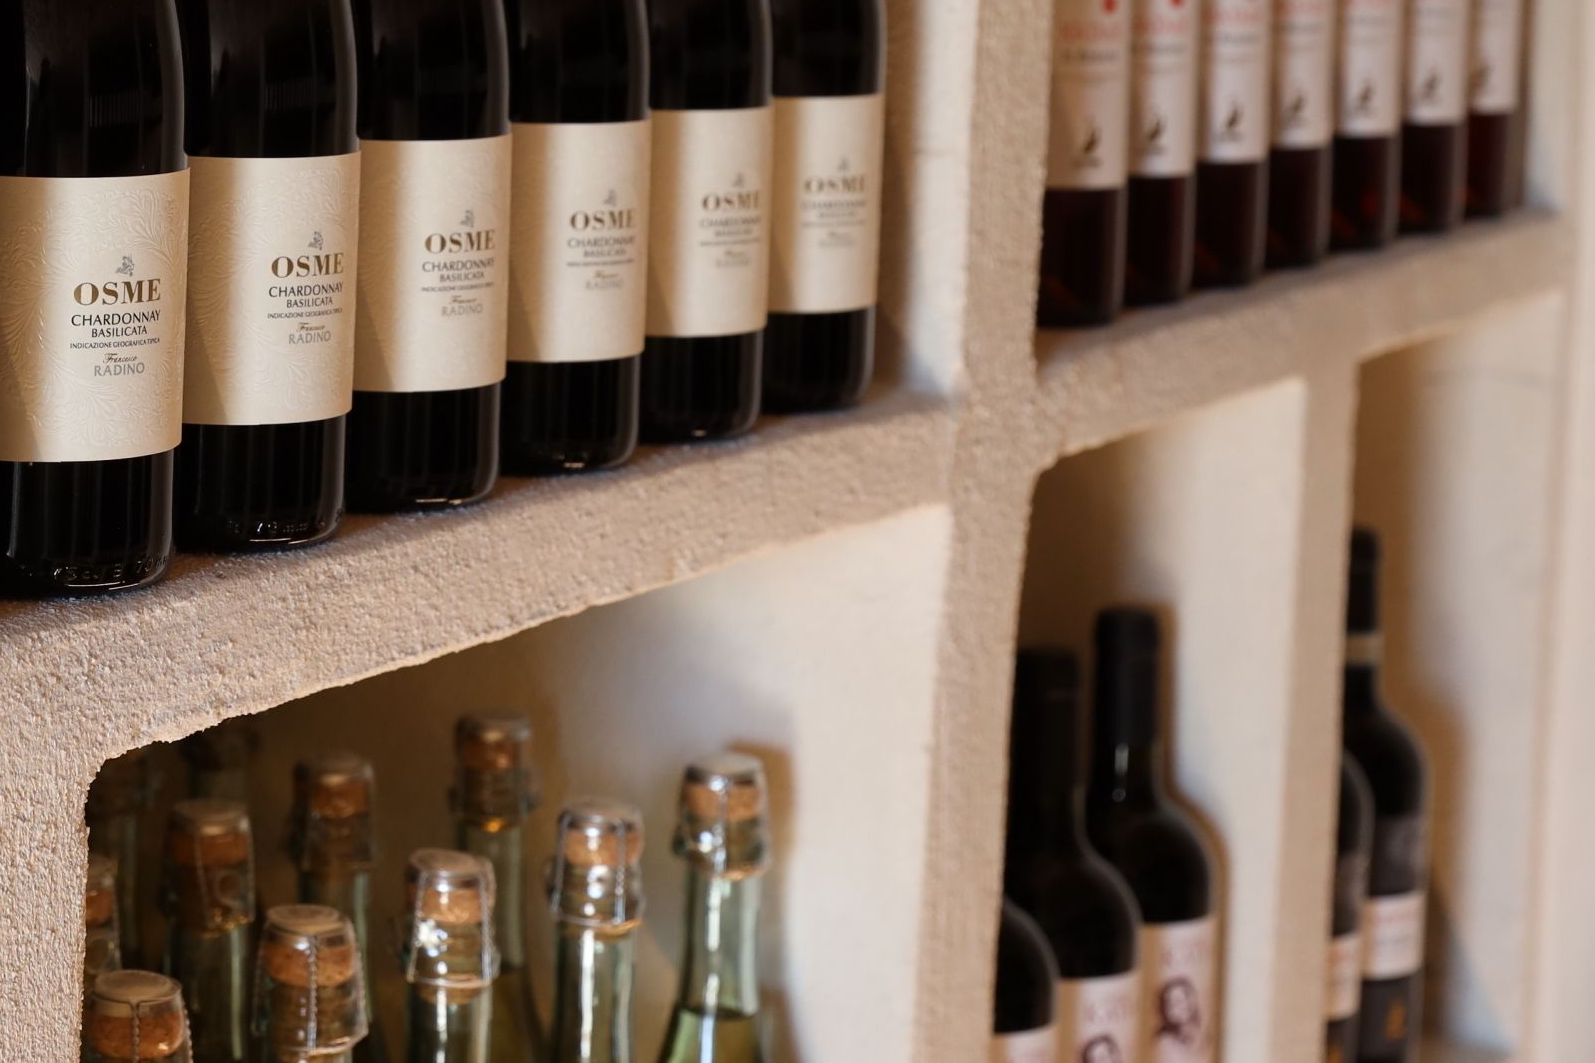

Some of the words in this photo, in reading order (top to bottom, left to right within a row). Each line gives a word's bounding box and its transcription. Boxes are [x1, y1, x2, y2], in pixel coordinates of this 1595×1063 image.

[570, 208, 637, 231] OSME
[424, 230, 496, 254] OSME
[271, 252, 344, 278] OSME
[421, 257, 495, 272] CHARDONNAY
[439, 271, 486, 282] BASILICATA
[73, 278, 161, 306] OSME
[268, 282, 343, 297] CHARDONNAY
[286, 297, 333, 308] BASILICATA
[441, 303, 484, 317] RADINO
[71, 310, 161, 326] CHARDONNAY
[91, 325, 148, 338] BASILICATA
[288, 330, 332, 344] RADINO
[70, 341, 112, 349] INDICAZIONE
[94, 362, 145, 376] RADINO
